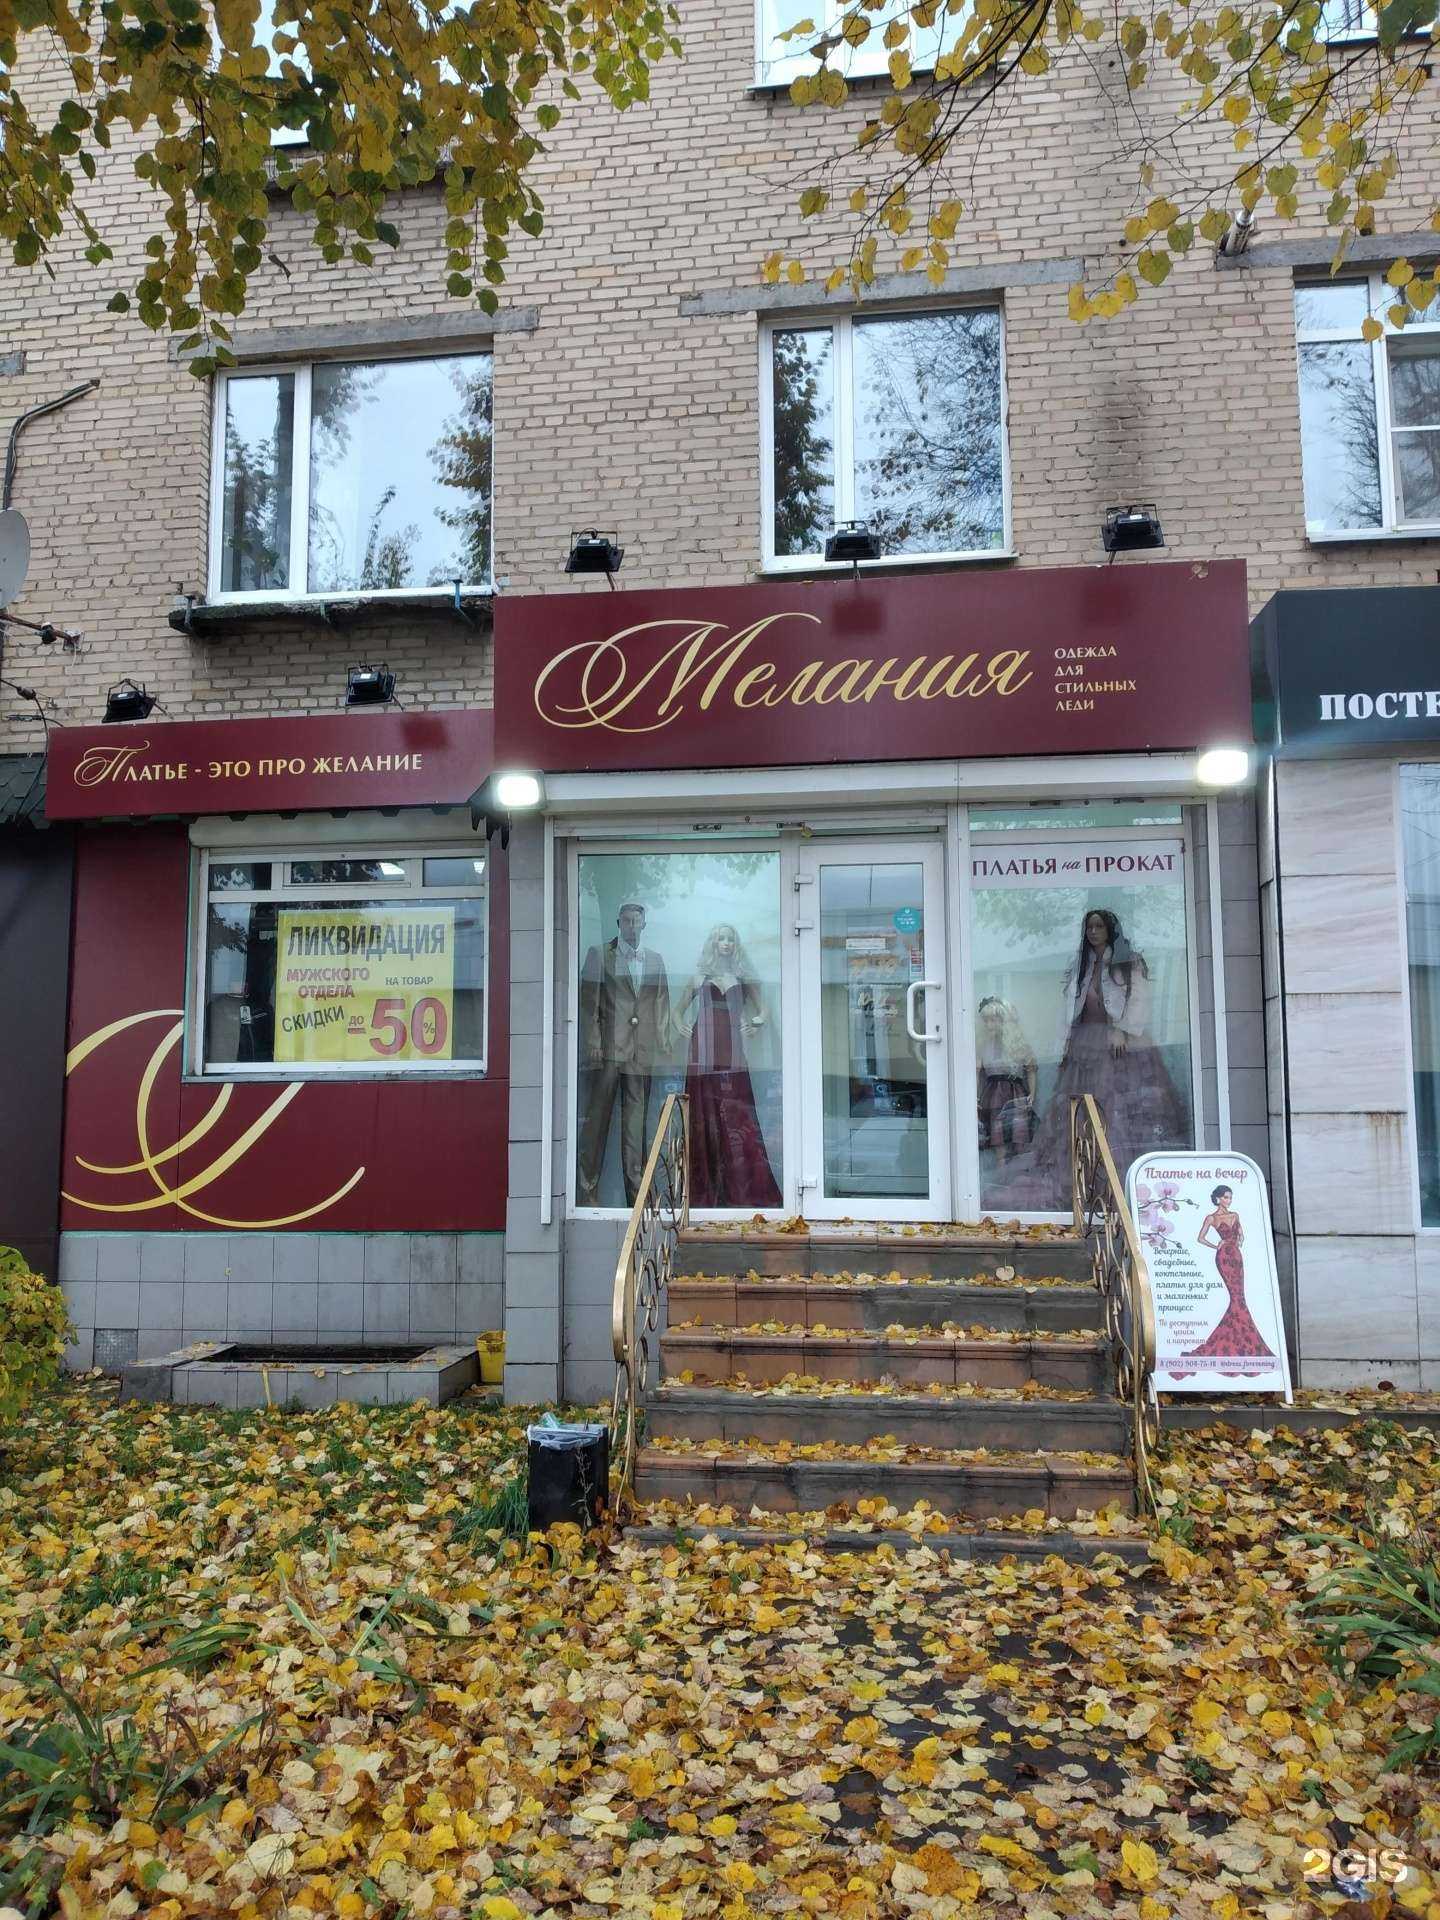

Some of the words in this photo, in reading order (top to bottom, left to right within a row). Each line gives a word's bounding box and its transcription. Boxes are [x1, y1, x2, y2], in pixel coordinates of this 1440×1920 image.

[1054, 645, 1118, 659] ОДЕЖДА
[534, 611, 1034, 733] Мелания
[1054, 664, 1084, 677] ДЛЯ
[1054, 680, 1137, 694] СТИЛЬНЫХ
[1055, 699, 1095, 712] ЛЕДИ
[208, 759, 251, 778] ЭТО
[258, 757, 306, 776] ПРО
[311, 753, 423, 775] ЖЕЛАНИЕ
[972, 858, 1057, 877] ПЛАТЬЯ
[1061, 859, 1082, 872] на
[1085, 854, 1176, 874] ПРОКАТ
[287, 923, 446, 961] ЛИКВИДАЦИЯ
[286, 967, 370, 982] МУЖСКОГО
[385, 976, 400, 986] НА
[402, 976, 434, 985] ТОВАР
[298, 985, 355, 1000] ОТДЕЛА
[281, 1004, 345, 1033] СКИДКИ
[1144, 1167, 1193, 1180] Платье
[1196, 1169, 1212, 1179] на
[1215, 1167, 1248, 1184] вечер
